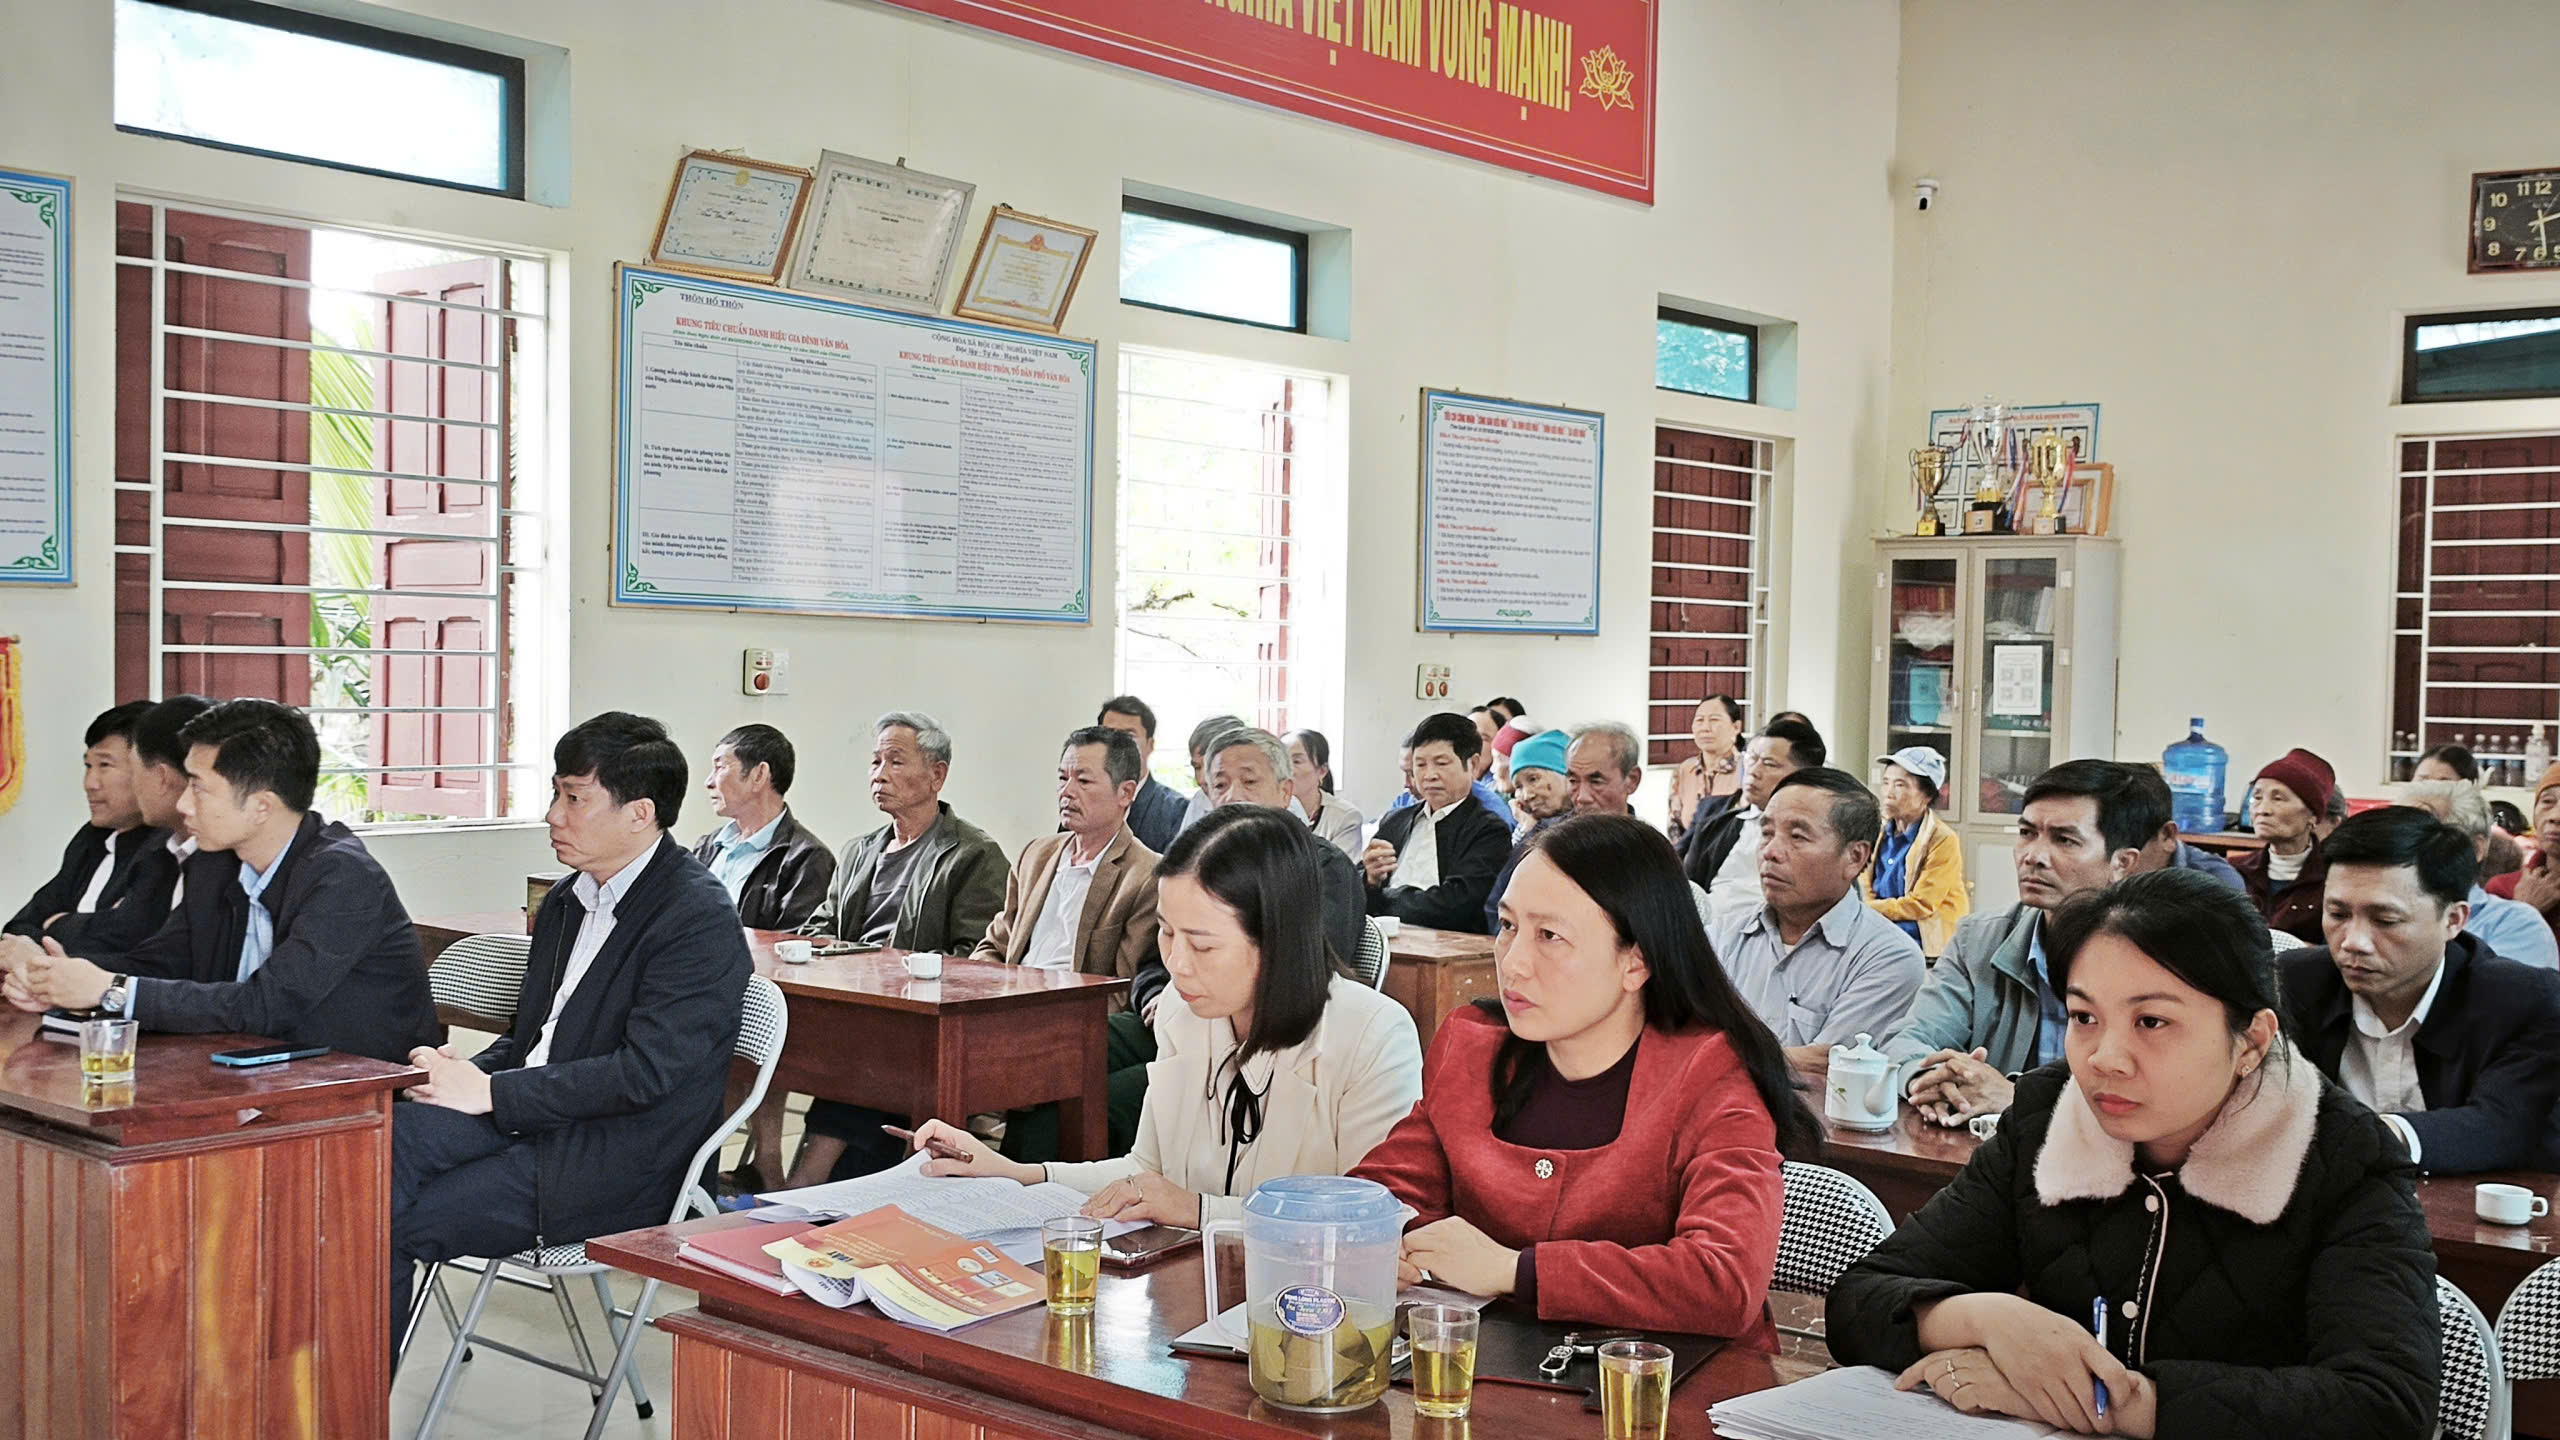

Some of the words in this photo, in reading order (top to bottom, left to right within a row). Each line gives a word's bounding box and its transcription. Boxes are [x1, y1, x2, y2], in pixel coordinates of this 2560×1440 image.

[1363, 0, 1421, 68] NAM
[1497, 2, 1572, 120] MẠNH!
[2517, 182, 2530, 196] 11
[2534, 181, 2552, 195] 12
[2489, 192, 2508, 207] 10
[2483, 217, 2496, 232] 9
[2487, 241, 2500, 256] 8
[2514, 247, 2527, 261] 7
[2533, 246, 2547, 260] 6
[676, 316, 703, 328] KHUNG
[704, 320, 721, 331] TIÊU
[749, 327, 769, 339] DANH
[788, 334, 800, 343] GIA
